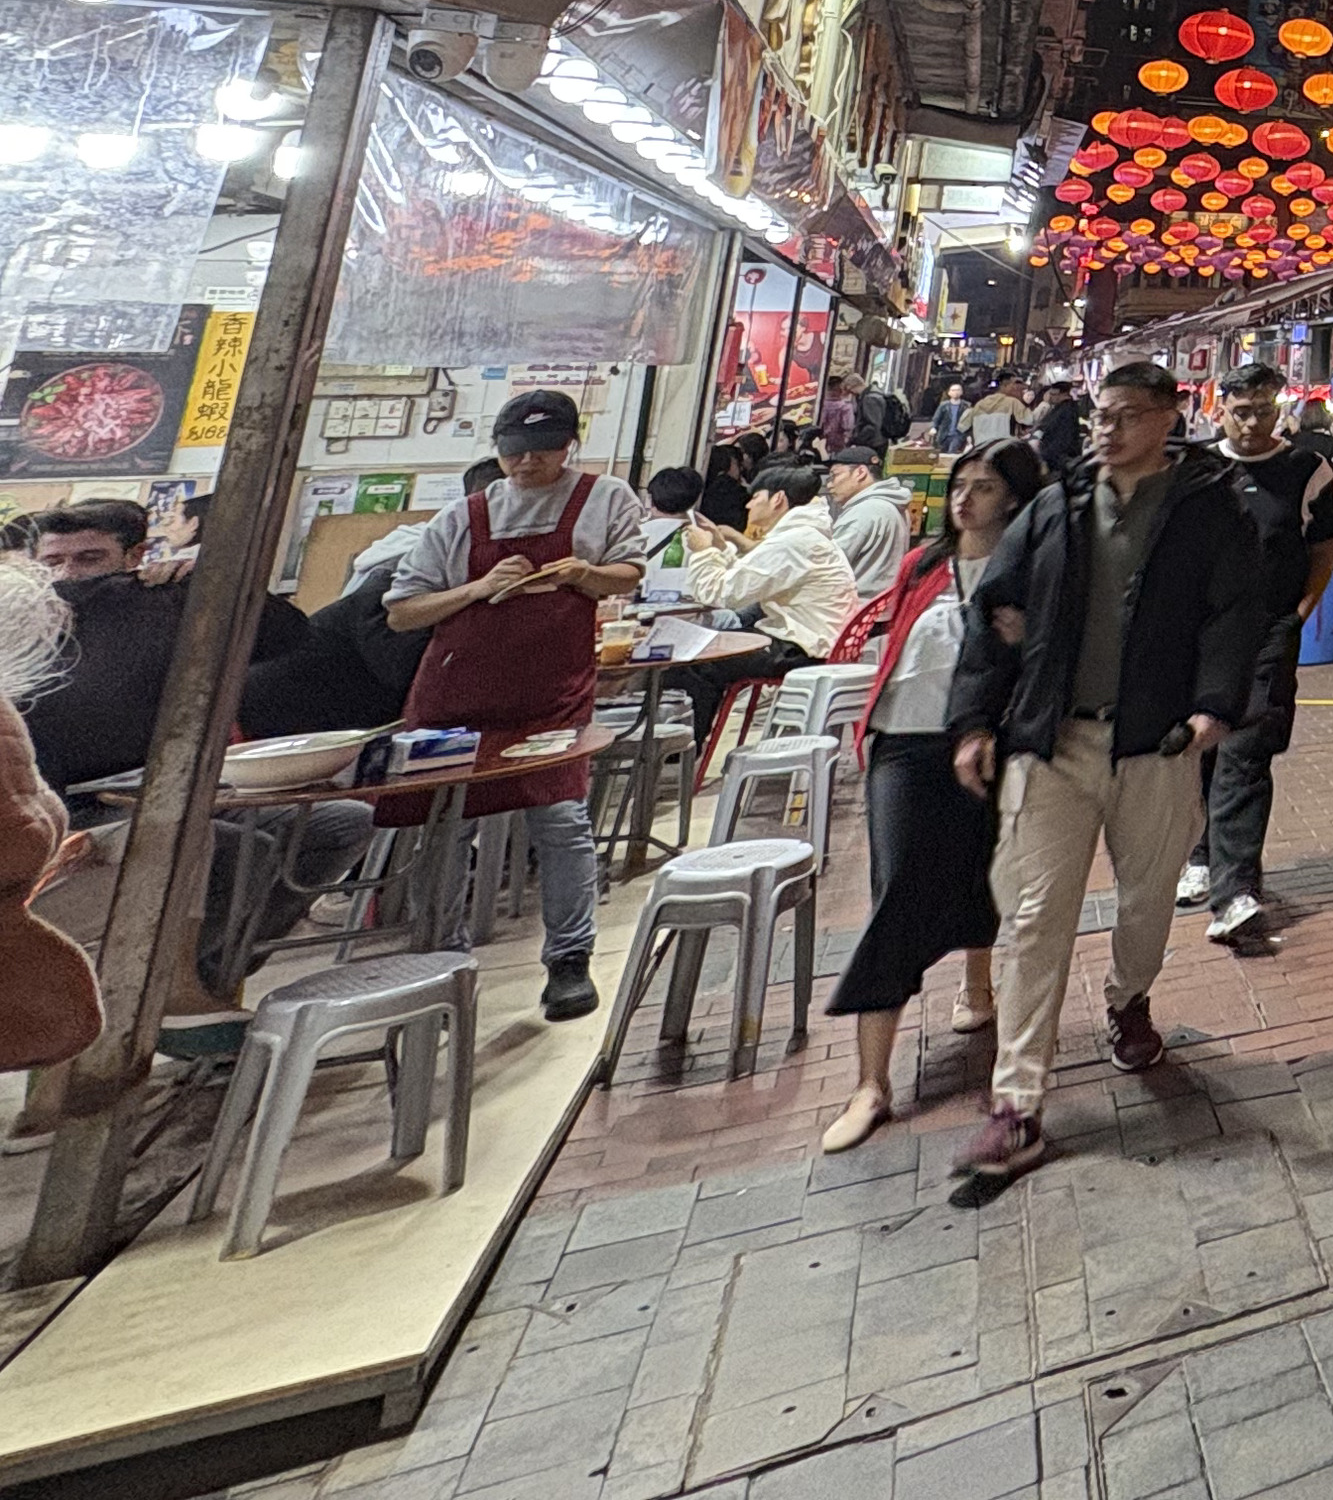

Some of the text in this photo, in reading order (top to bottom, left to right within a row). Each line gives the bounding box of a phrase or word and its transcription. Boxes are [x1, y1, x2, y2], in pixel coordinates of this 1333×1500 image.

[194, 312, 249, 422] 香辣小龍蝦
